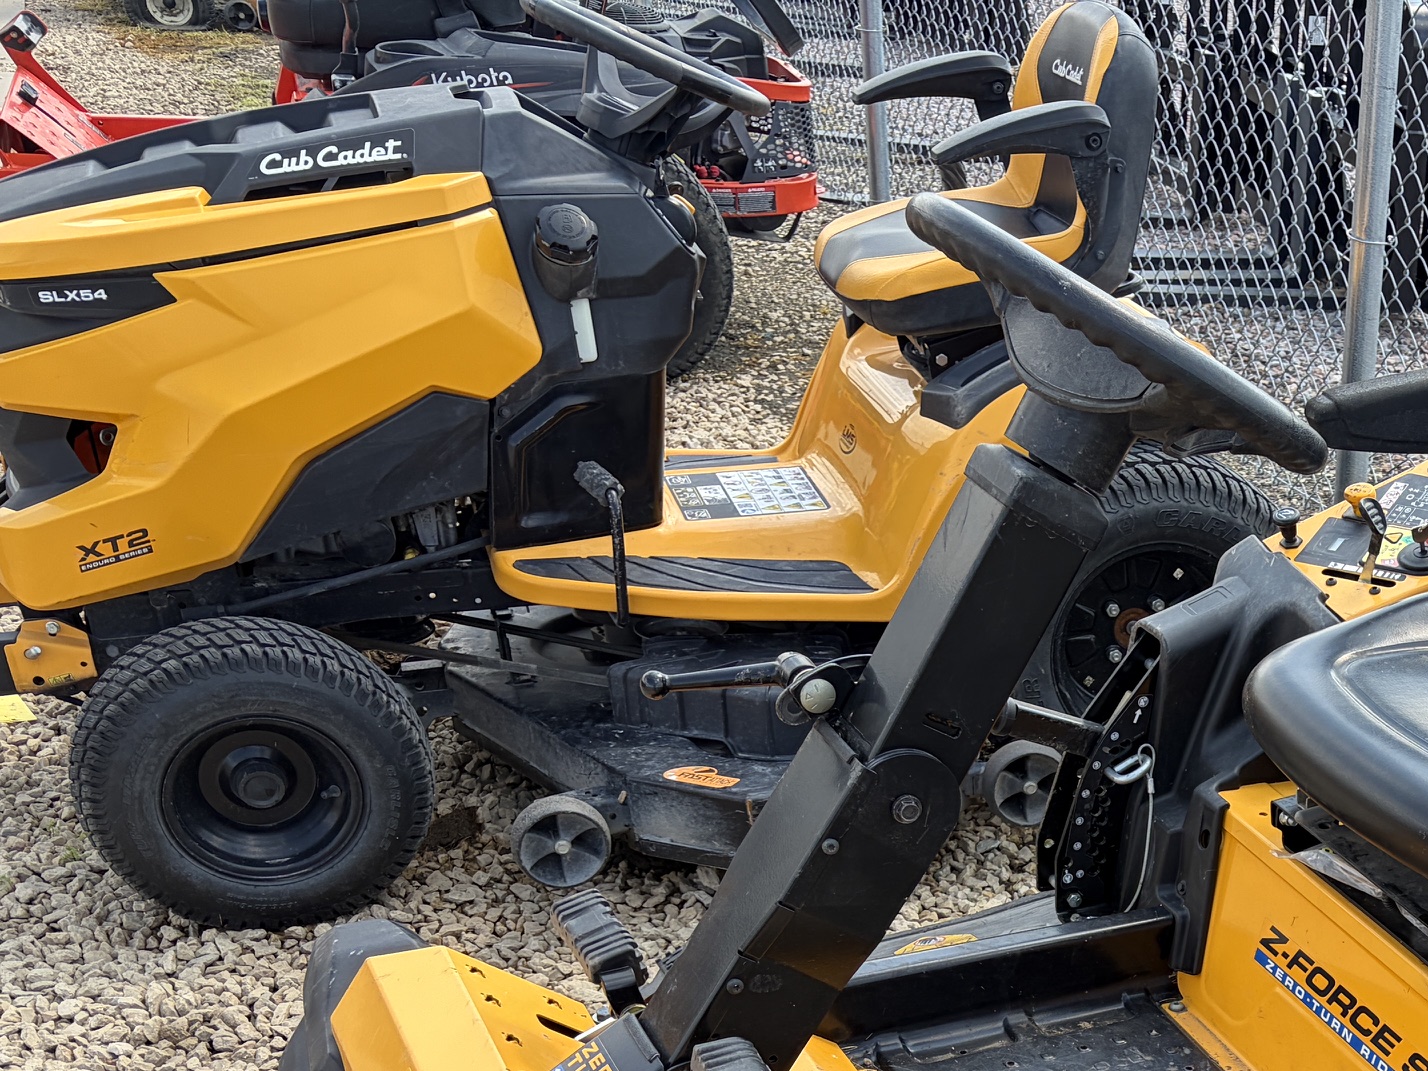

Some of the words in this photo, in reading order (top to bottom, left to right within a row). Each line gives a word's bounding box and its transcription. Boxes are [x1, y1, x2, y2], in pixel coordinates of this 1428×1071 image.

[1052, 59, 1066, 78] Cub
[1065, 64, 1084, 86] Cadet
[259, 151, 314, 175] Cub
[316, 138, 402, 167] Cadet
[37, 288, 108, 303] SLX54
[75, 527, 152, 563] XT2
[81, 556, 116, 571] ENDURO
[119, 547, 149, 560] SERIES
[1259, 925, 1403, 1057] Z-FORCE
